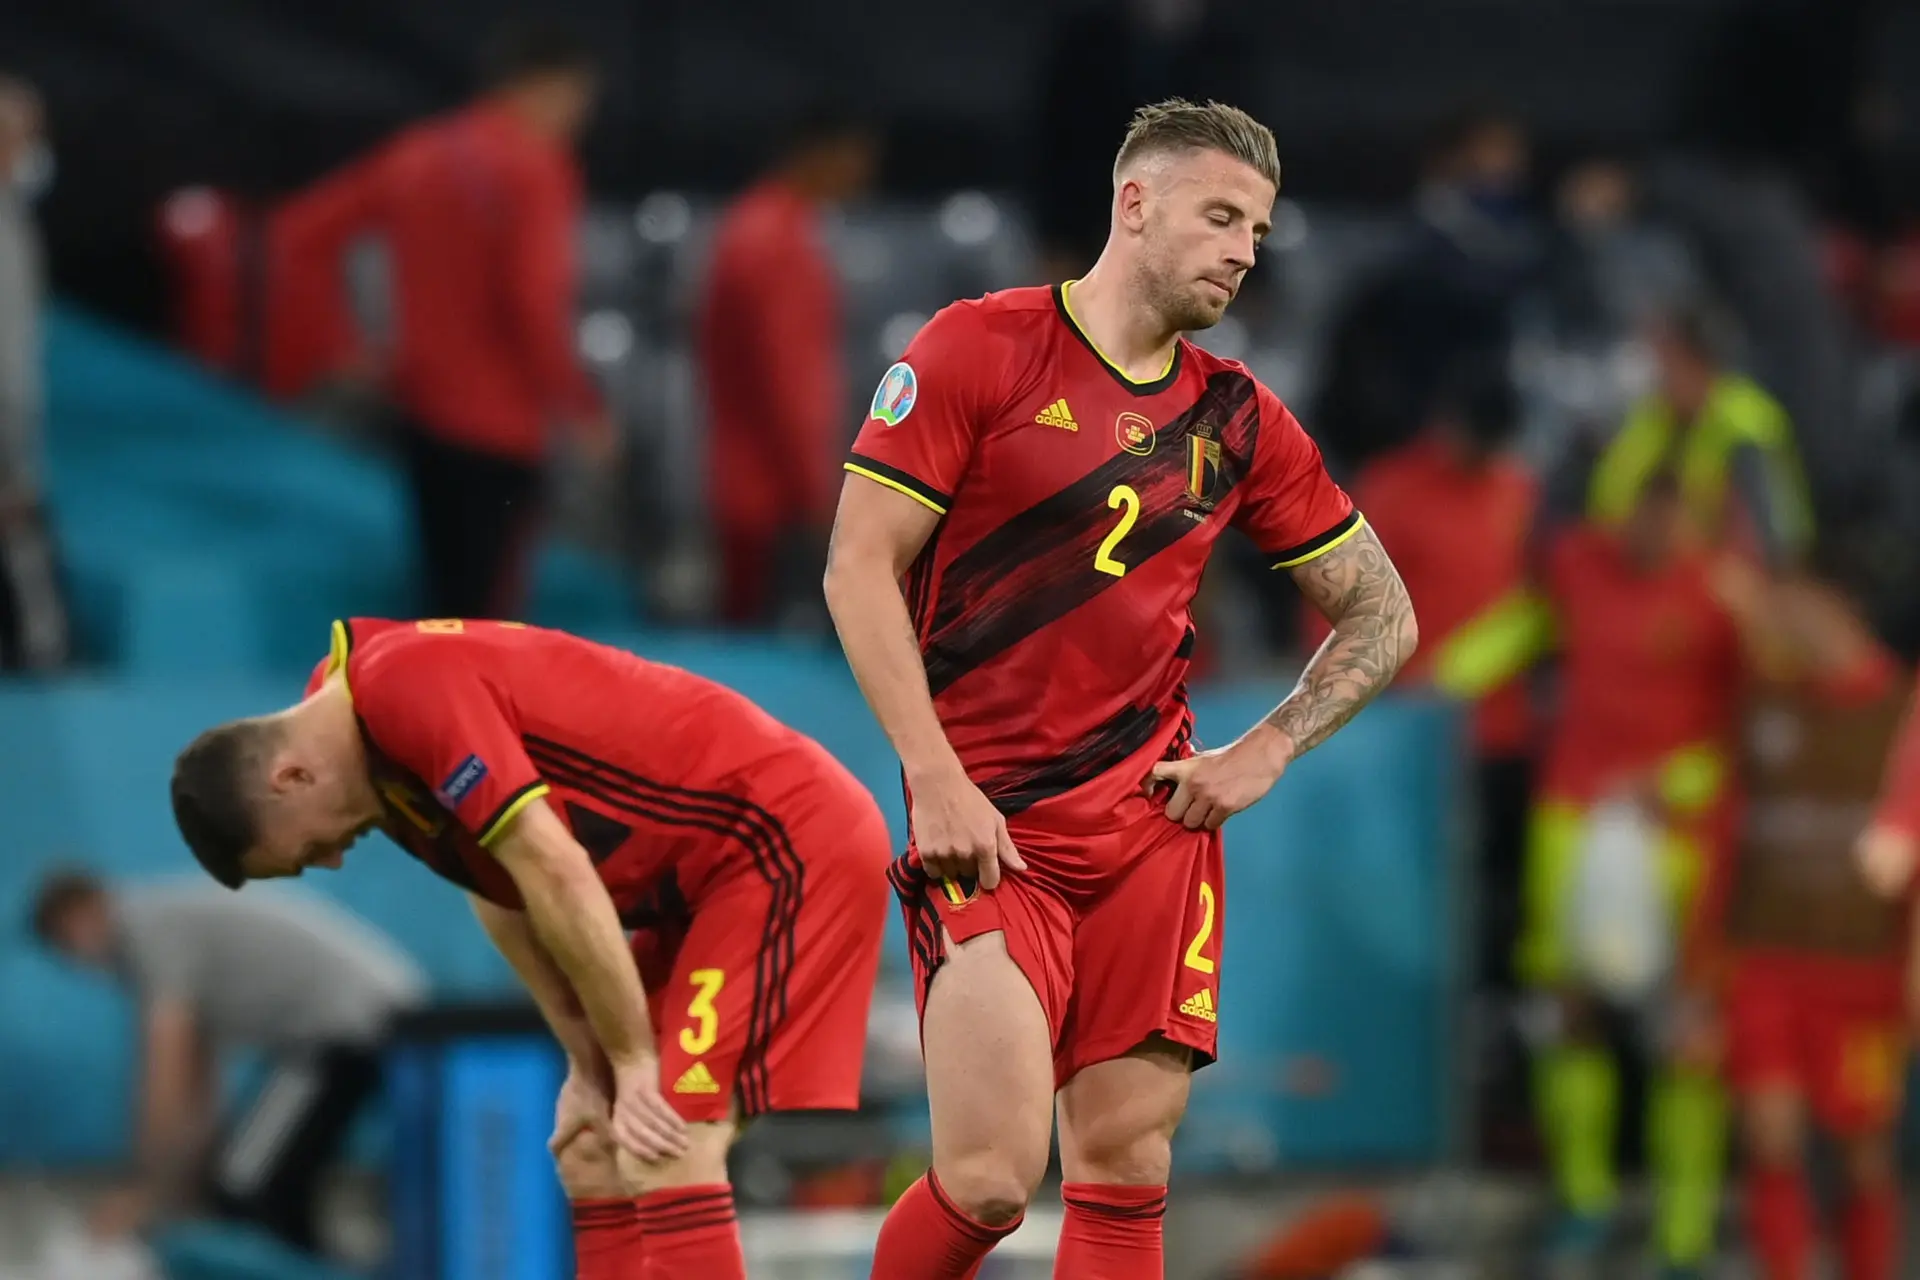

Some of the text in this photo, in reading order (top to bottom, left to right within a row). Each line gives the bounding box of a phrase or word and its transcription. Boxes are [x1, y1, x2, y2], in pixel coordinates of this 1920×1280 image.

[1035, 414, 1078, 432] adidas
[1094, 485, 1140, 577] 2
[1184, 881, 1215, 974] 2
[679, 968, 725, 1056] 3
[1179, 1003, 1217, 1022] adidas
